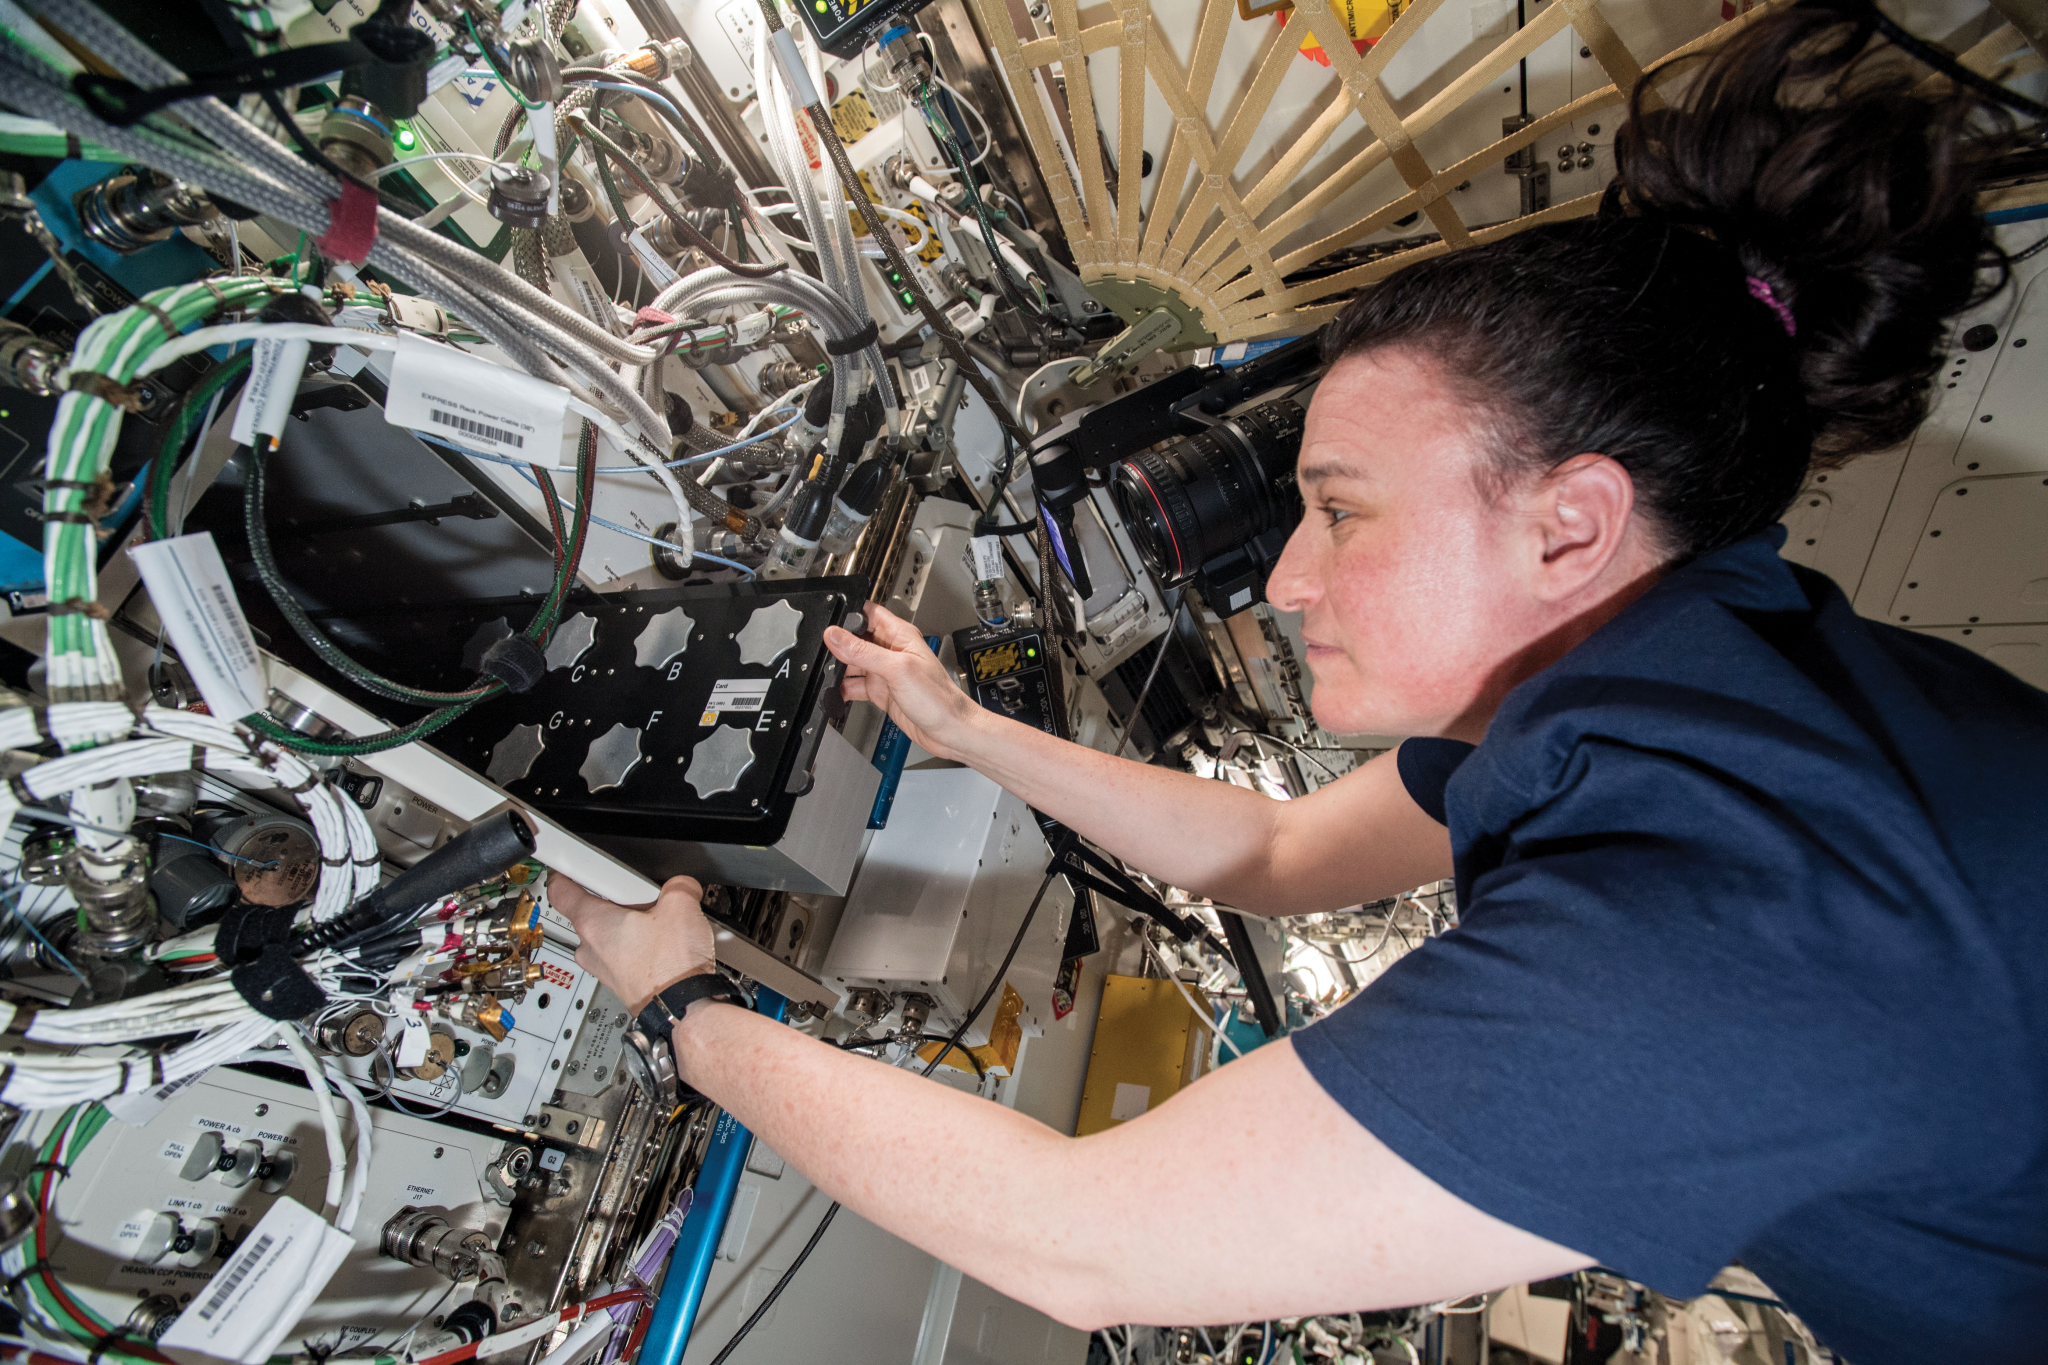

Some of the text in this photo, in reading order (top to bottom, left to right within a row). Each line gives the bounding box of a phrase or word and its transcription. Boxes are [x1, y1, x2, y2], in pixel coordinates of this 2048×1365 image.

[832, 109, 853, 140] CAUTION
[799, 136, 817, 161] FIRE
[420, 391, 458, 408] EXPRESS
[458, 404, 476, 414] Rack
[477, 410, 499, 421] Power
[499, 416, 519, 427] Cable
[636, 518, 650, 532] Return
[603, 564, 621, 581] Ethernet
[571, 665, 585, 683] C
[667, 662, 683, 681] B
[775, 659, 791, 679] A
[988, 687, 998, 701] OFF
[1035, 680, 1046, 694] 120
[1038, 696, 1049, 712] VDC
[548, 711, 562, 730] G
[645, 711, 663, 731] F
[755, 711, 775, 732] E
[345, 758, 355, 768] cb
[410, 795, 440, 815] POWER
[554, 915, 562, 923] 10
[1078, 907, 1091, 935] 120 VDC
[480, 1037, 498, 1047] POWER
[597, 1045, 605, 1059] S/N
[429, 1085, 442, 1097] J2
[197, 1117, 241, 1133] POWER A cb
[256, 1130, 298, 1145] POWER B cb
[164, 1149, 182, 1158] OPEN
[168, 1142, 185, 1151] PULL
[222, 1157, 233, 1168] 10
[546, 1154, 557, 1164] G2
[406, 1184, 435, 1195] ETHERNET
[167, 1198, 186, 1207] LINK
[192, 1201, 202, 1209] cb
[214, 1204, 233, 1214] LINK
[238, 1208, 247, 1216] cb
[124, 1222, 141, 1230] PULL
[119, 1230, 139, 1239] OPEN
[265, 1234, 293, 1269] EXPRESS
[120, 1262, 155, 1276] DRAGON
[156, 1266, 175, 1277] CCP
[252, 1266, 268, 1284] Rack
[162, 1278, 176, 1286] J14
[236, 1282, 255, 1305] Power
[221, 1302, 239, 1323] Cable
[349, 1325, 377, 1334] COUPLER
